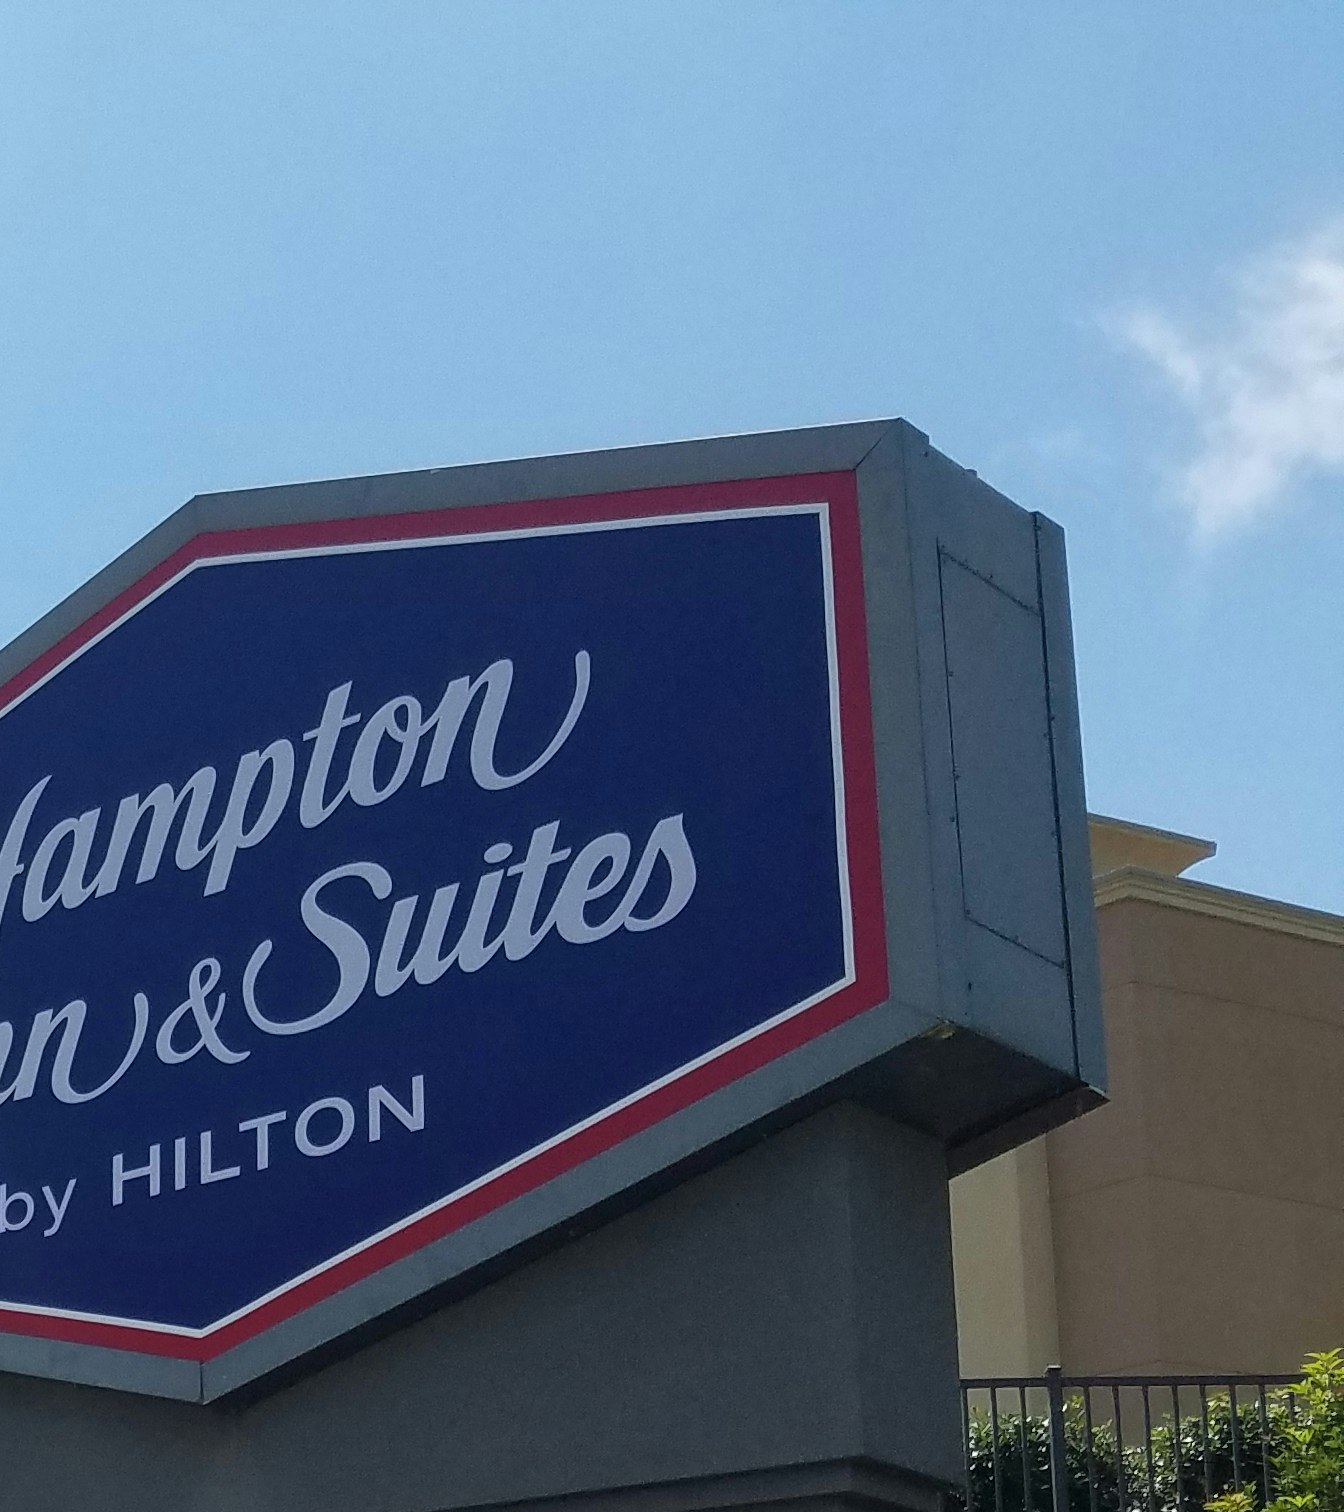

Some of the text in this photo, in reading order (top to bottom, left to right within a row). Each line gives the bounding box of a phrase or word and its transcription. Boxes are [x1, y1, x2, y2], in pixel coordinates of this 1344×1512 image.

[155, 956, 252, 1065] &
[241, 812, 698, 1036] Suites
[111, 1072, 427, 1207] HILTON
